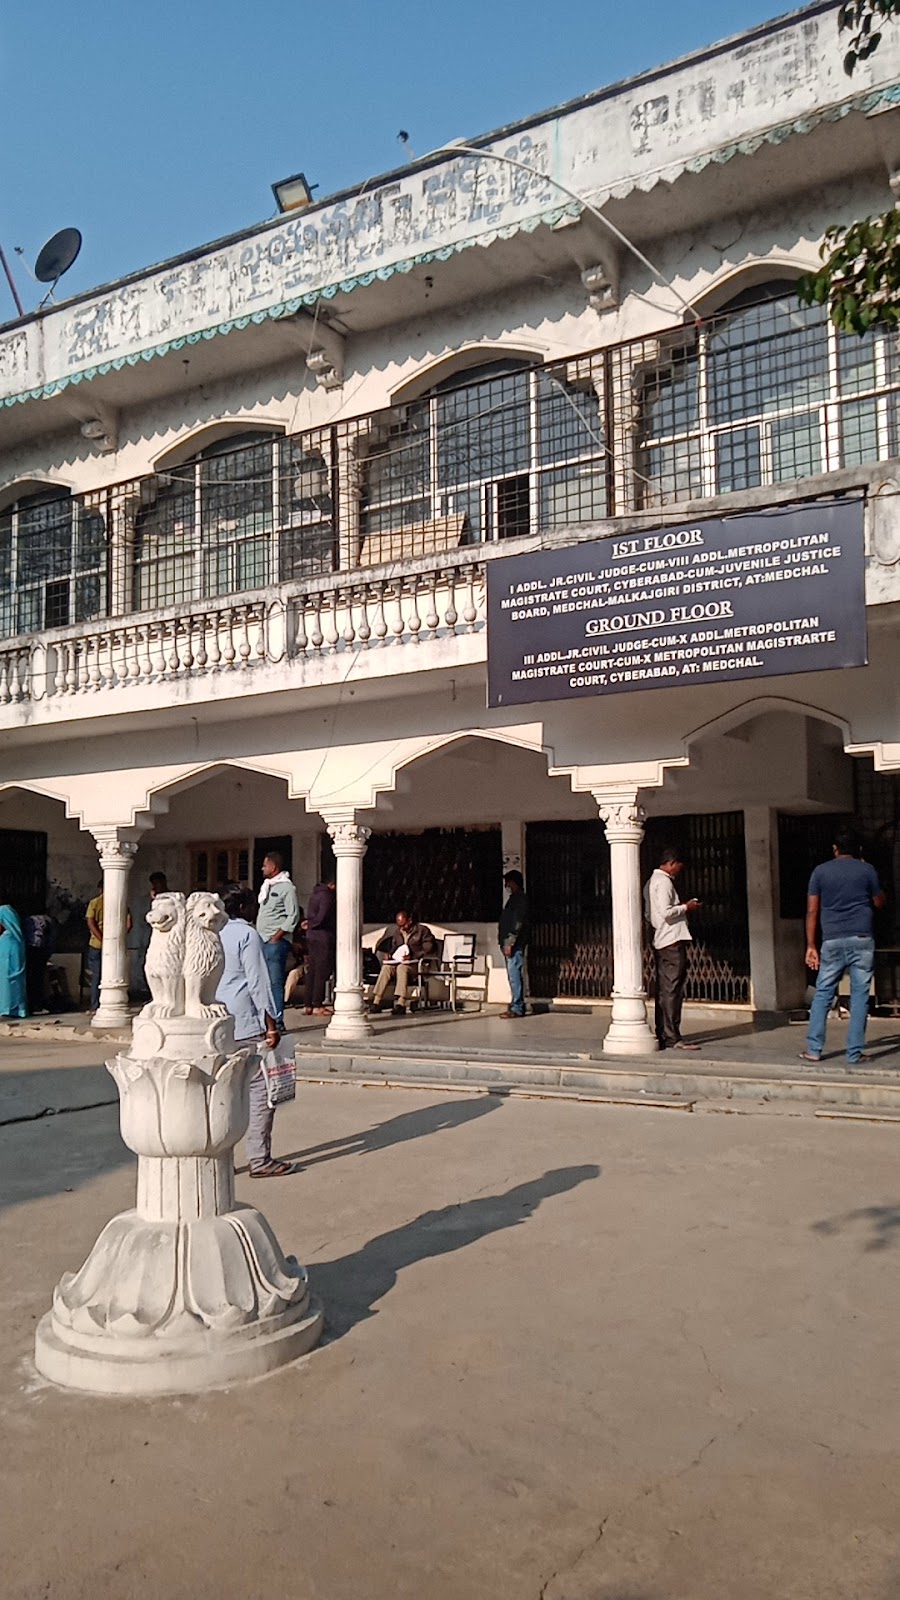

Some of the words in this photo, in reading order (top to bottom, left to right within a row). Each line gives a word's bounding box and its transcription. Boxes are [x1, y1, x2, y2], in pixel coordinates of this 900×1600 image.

[510, 585, 514, 594] I
[516, 581, 547, 594] ADDL.
[549, 572, 595, 587] JR.CIVIL
[597, 556, 689, 579] JUDGE-CUM-VIII
[692, 532, 830, 564] ADDL.METROPOLITAN
[644, 529, 703, 552] FLOOR
[500, 590, 569, 609] MAGISTRATE
[571, 582, 611, 598] COURT,
[613, 556, 781, 591] CYBERABAD-CUM-JUVENILE
[784, 546, 842, 565] JUSTICE
[511, 607, 550, 621] BOARD,
[552, 586, 680, 614] MEDCHAL-MALKAJGIRI
[683, 576, 742, 595] DISTRICT,
[745, 563, 830, 586] AT:MEDCHAL
[524, 655, 535, 665] III
[536, 644, 610, 664] ADDL.JR.CIVIL
[612, 634, 688, 654] JUDGE-CUM-X
[690, 616, 819, 643] ADDL.METROPOLITAN
[585, 610, 665, 634] GROUND
[670, 600, 734, 622] FLOOR
[511, 663, 576, 681] MAGISTRATE
[578, 653, 652, 672] COURT-CUM-X
[654, 642, 744, 663] METROPOLITAN
[746, 631, 836, 652] MAGISTRARTE
[569, 674, 608, 688] COURT,
[610, 665, 680, 684] CYBERABAD,
[682, 662, 700, 675] AT:
[702, 656, 764, 673] MEDCHAL.
